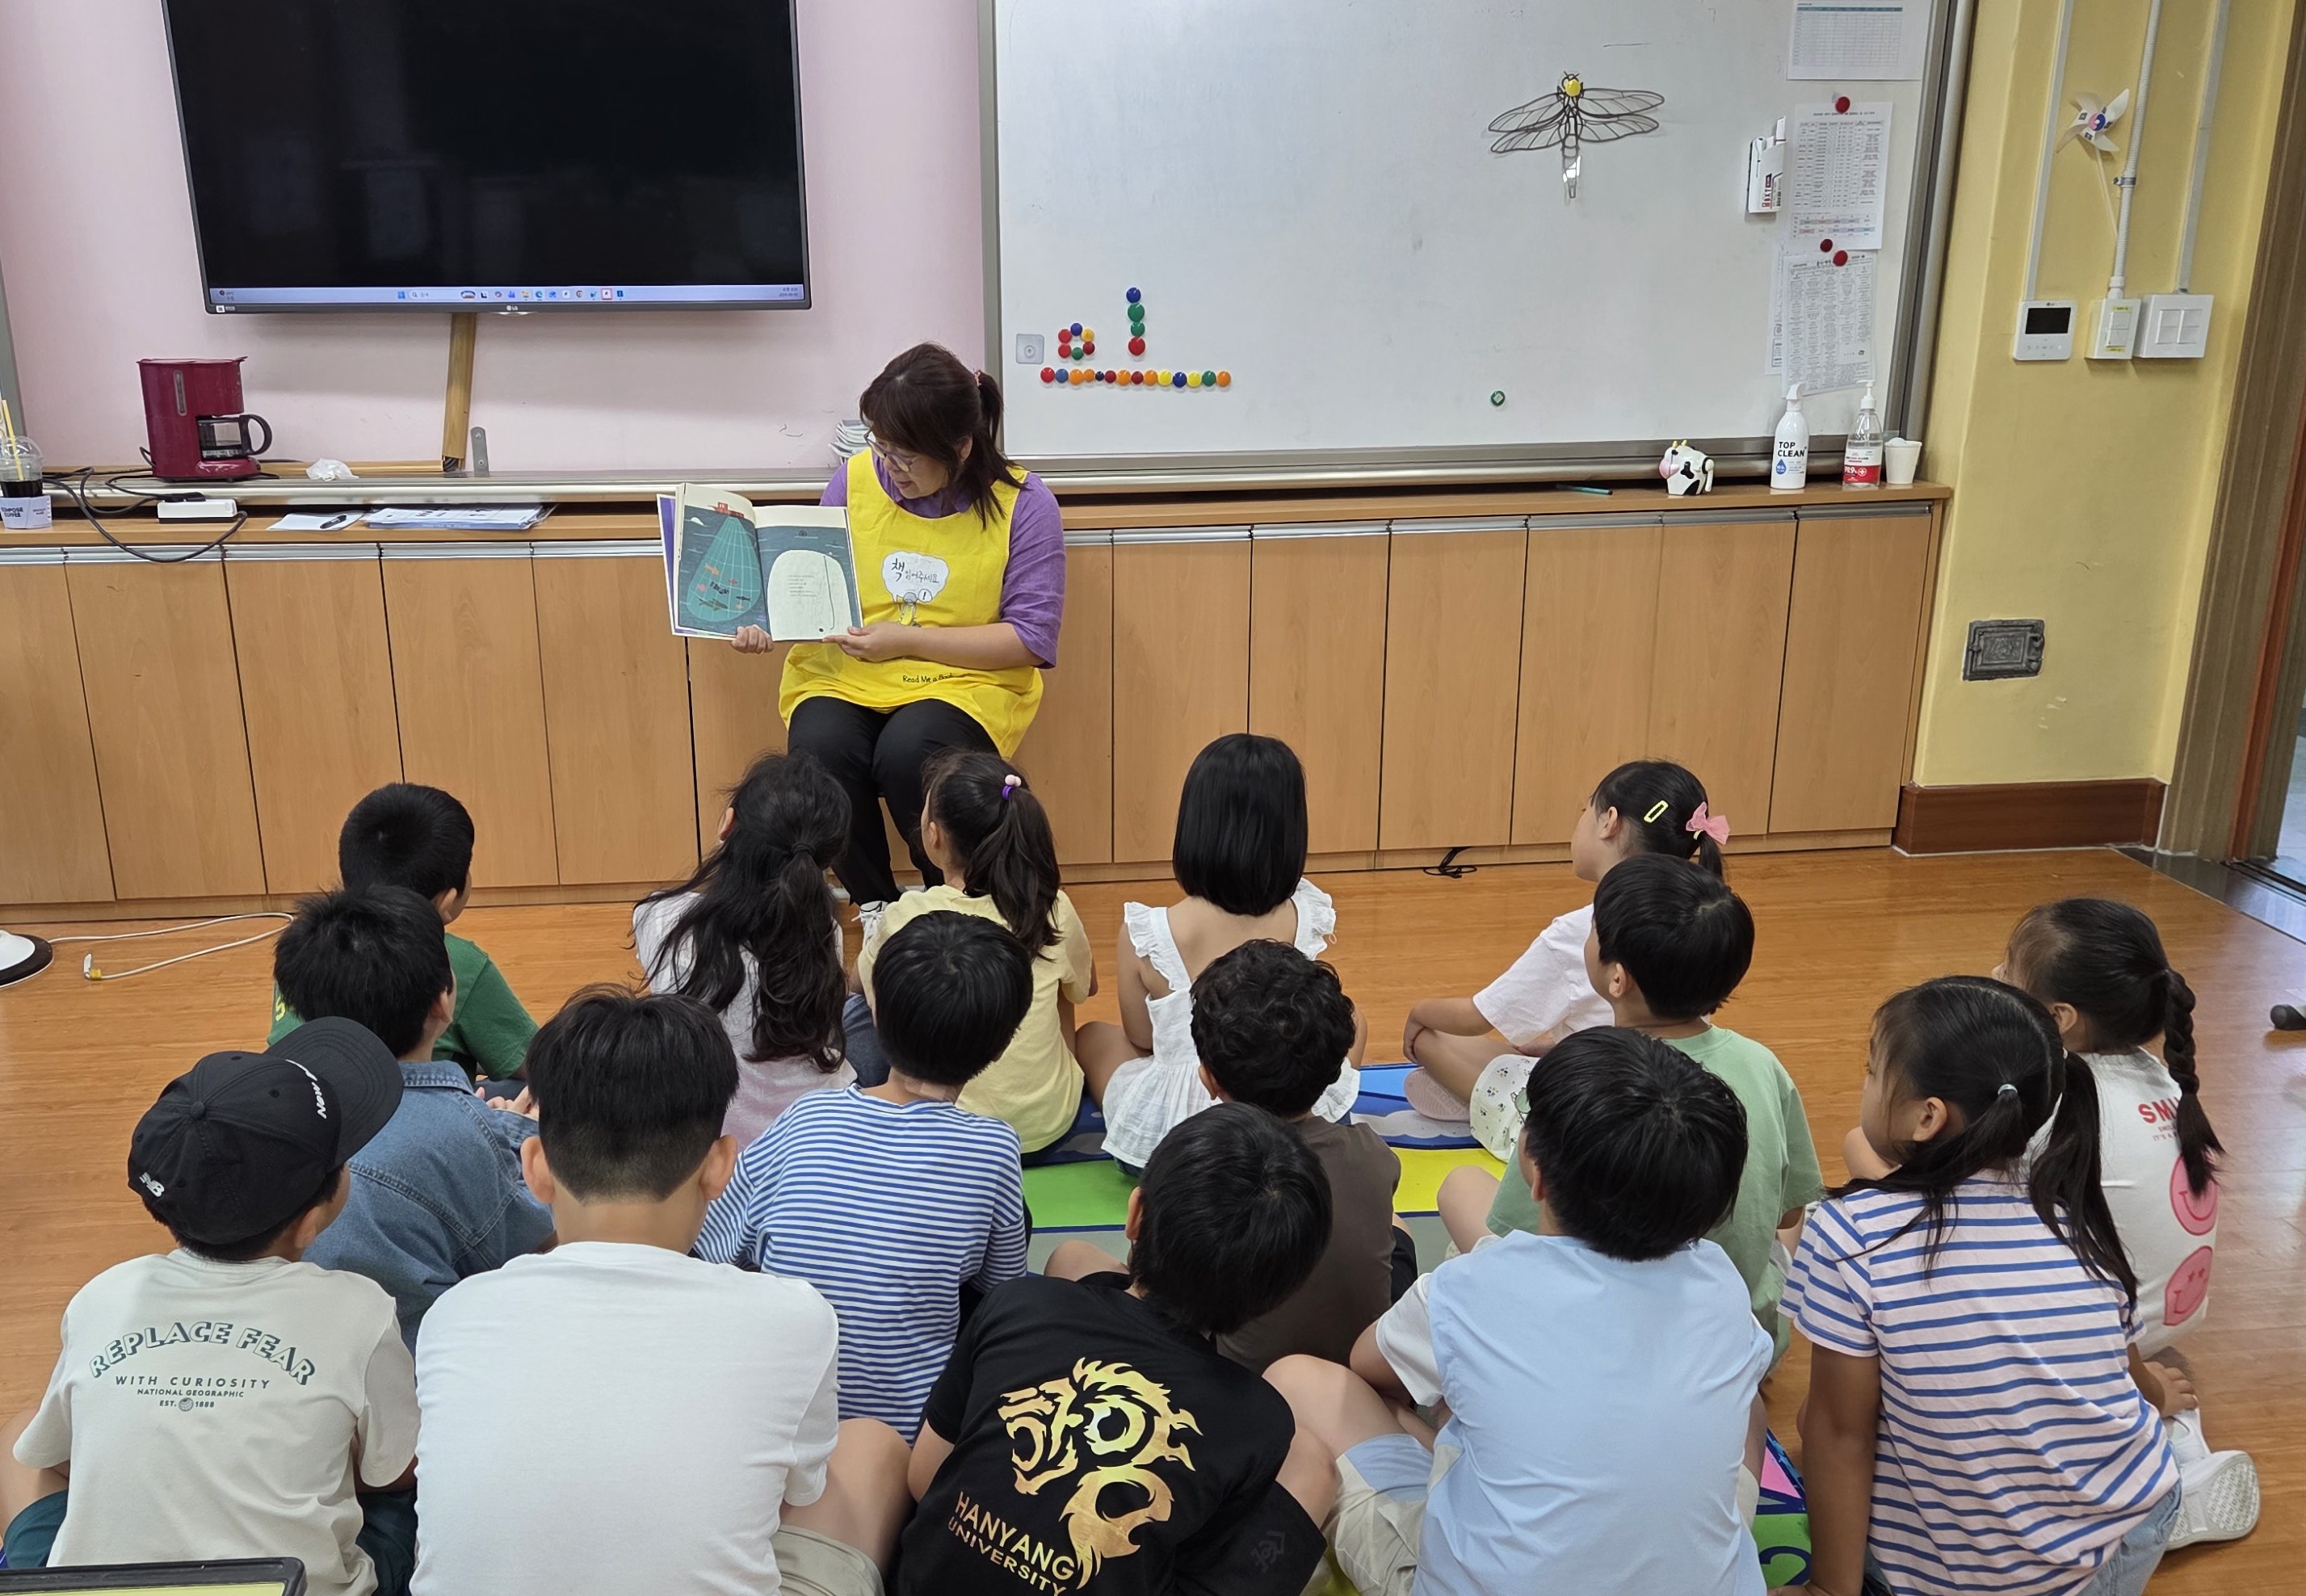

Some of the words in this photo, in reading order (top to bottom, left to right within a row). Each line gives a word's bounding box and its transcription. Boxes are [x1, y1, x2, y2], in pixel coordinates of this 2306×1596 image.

[1777, 449, 1805, 458] CLEAN
[1779, 441, 1796, 449] TOP
[891, 558, 905, 582] 책
[89, 1321, 233, 1378] REPLACE
[235, 1327, 316, 1386] FEAR
[116, 1376, 158, 1385] WITH
[170, 1376, 270, 1389] CURIOSITY
[186, 1389, 245, 1398] GEOGRAPHIC
[955, 1491, 1075, 1581] HANYANG
[948, 1516, 1067, 1596] UNIVERSITY
